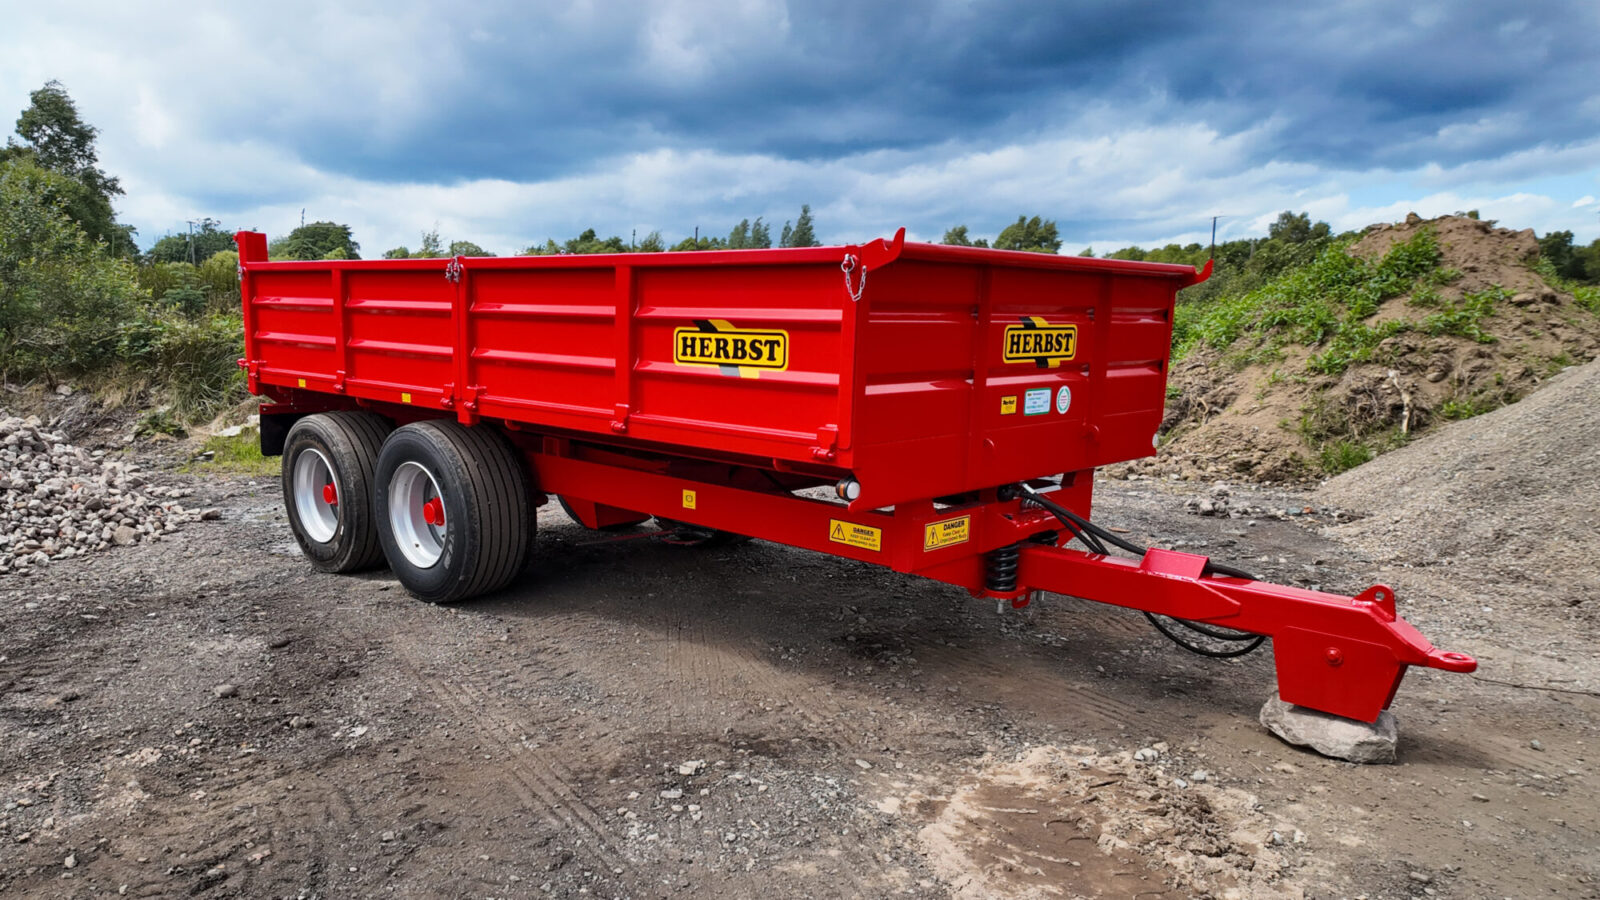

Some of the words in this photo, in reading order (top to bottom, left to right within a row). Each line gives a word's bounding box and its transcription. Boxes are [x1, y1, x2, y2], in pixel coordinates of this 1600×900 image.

[681, 336, 781, 361] HERBST
[1008, 333, 1073, 354] HERBST
[853, 527, 874, 537] DANGER
[943, 520, 965, 531] DANGER
